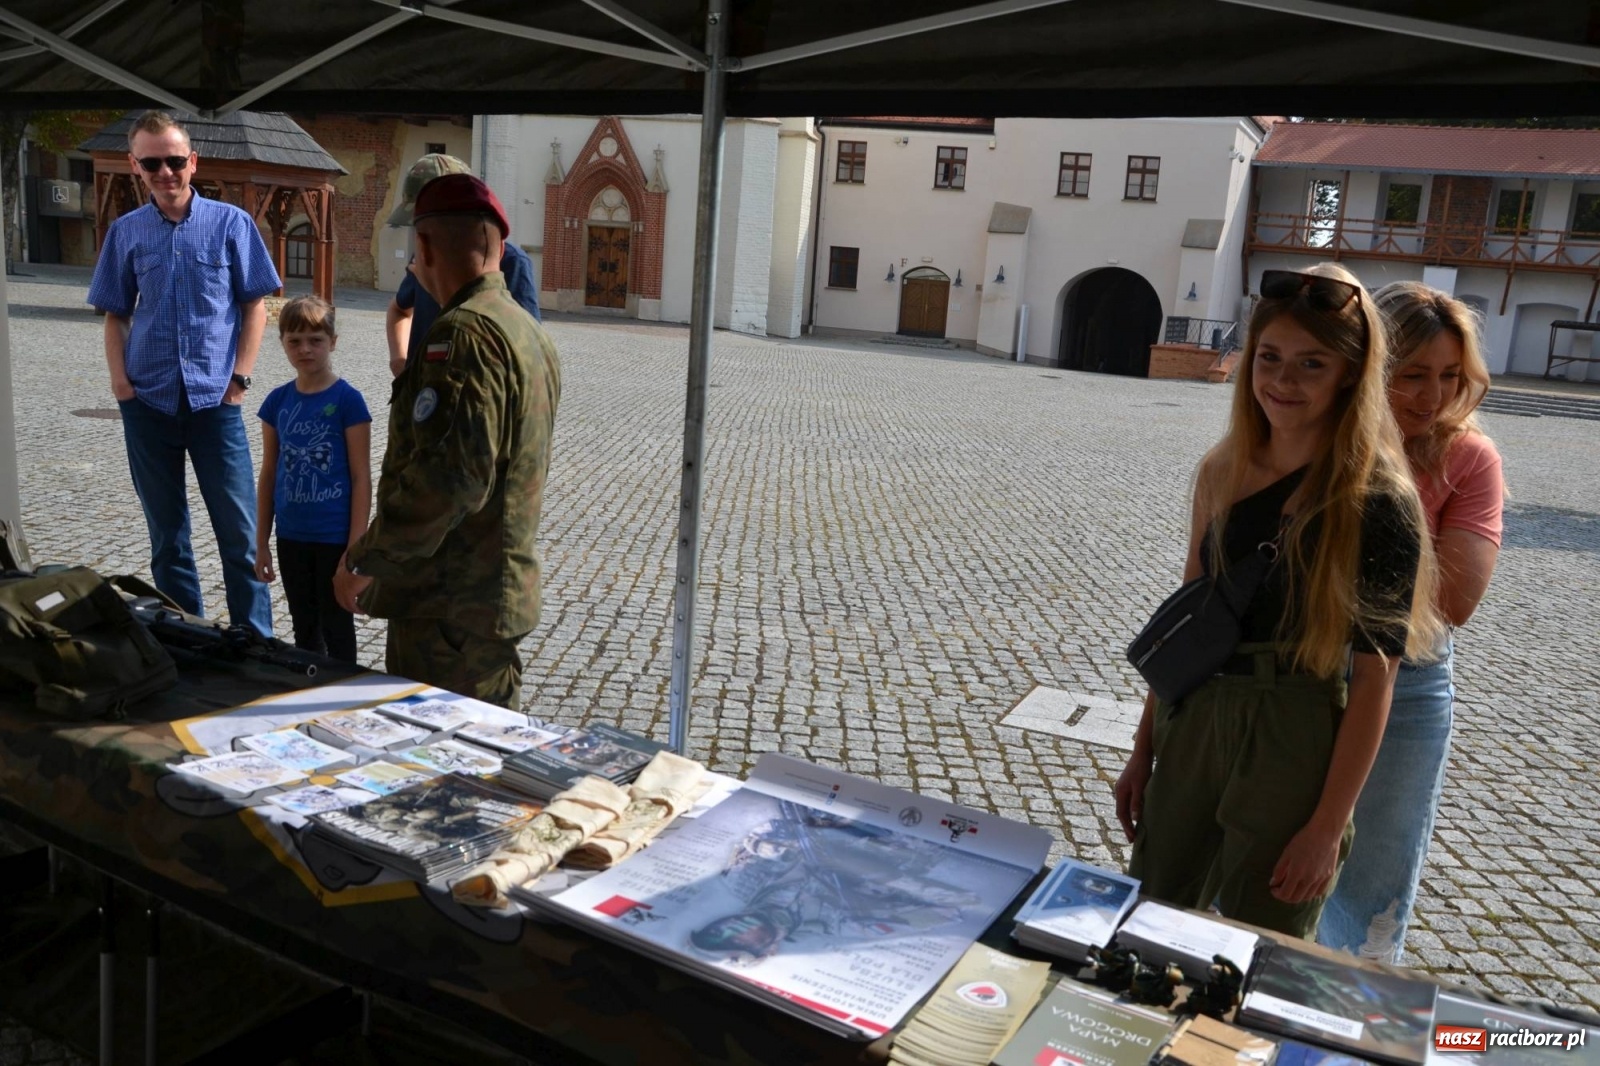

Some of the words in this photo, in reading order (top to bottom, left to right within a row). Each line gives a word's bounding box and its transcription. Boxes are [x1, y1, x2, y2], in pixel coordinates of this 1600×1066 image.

[278, 401, 333, 446] Classy
[299, 462, 311, 477] &
[813, 991, 887, 1020] UNIKATOWE
[1052, 1006, 1152, 1047] DROGOWA
[1069, 1024, 1121, 1047] MAPA
